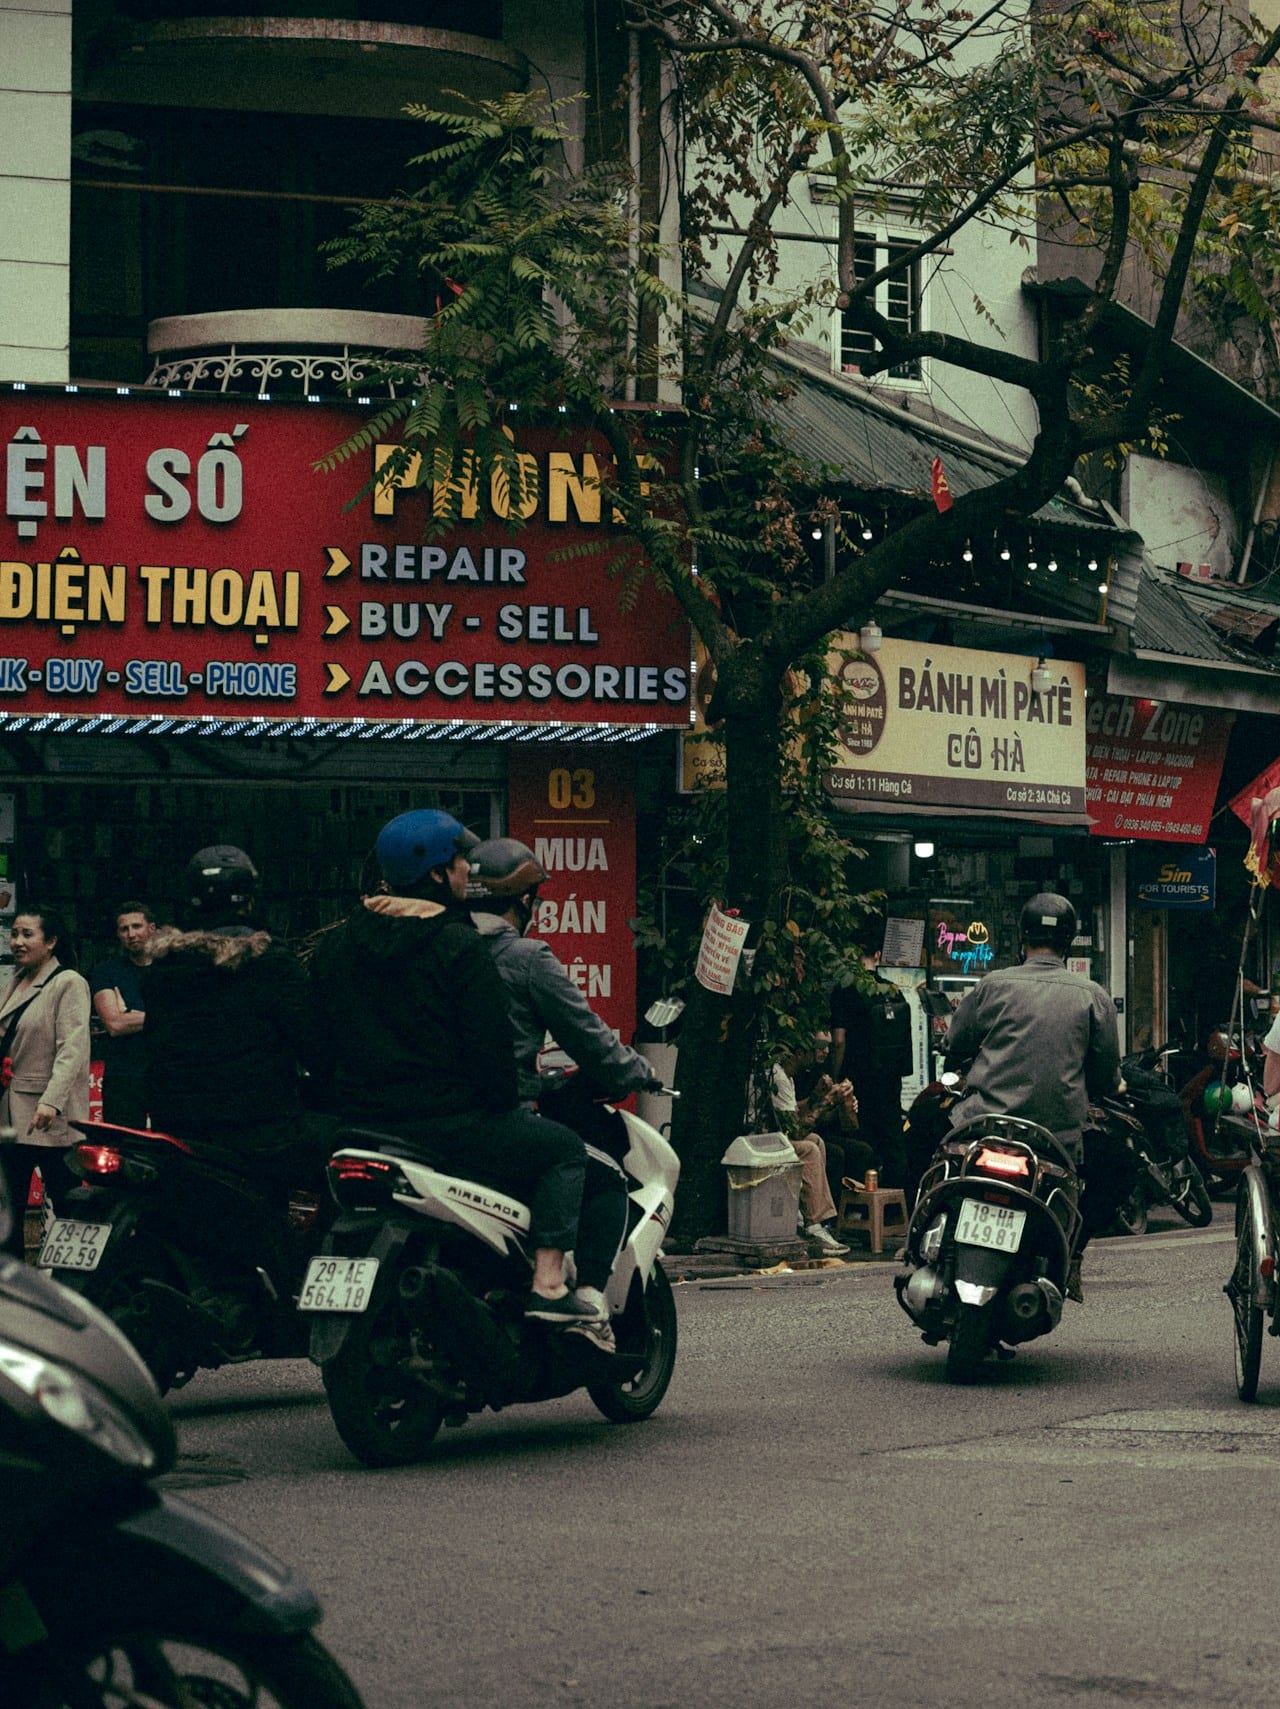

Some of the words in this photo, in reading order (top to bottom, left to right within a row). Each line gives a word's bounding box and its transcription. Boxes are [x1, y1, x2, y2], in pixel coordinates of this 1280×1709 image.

[145, 424, 249, 523] SỐ
[361, 544, 527, 582] REPAIR
[0, 547, 126, 635] ĐIỆN
[140, 566, 300, 644] THOẠI
[361, 602, 453, 637] BUY
[499, 604, 598, 641] SELL
[46, 659, 103, 692] BUY
[125, 660, 188, 696] SELL
[206, 661, 298, 697] PHONE
[359, 660, 687, 701] ACCESSORIES
[899, 658, 973, 717] BÁNH
[981, 668, 1007, 720] MÌ
[1014, 676, 1072, 727] PATÊ
[1141, 700, 1204, 746] Zone
[948, 727, 982, 769] CÔ
[991, 731, 1026, 773] HÀ
[1136, 749, 1162, 766] LAPTOP
[548, 768, 596, 810] 03
[868, 778, 877, 791] 11
[879, 775, 900, 797] Hàng
[901, 778, 912, 795] Cá
[1103, 768, 1128, 784] REPAIR
[1128, 770, 1152, 787] PHONE
[1158, 774, 1183, 790] LAPTOP
[1036, 789, 1046, 804] 3A
[1061, 790, 1071, 805] Cá
[534, 837, 608, 871] MUA
[1139, 884, 1159, 893] FOR
[1161, 885, 1209, 894] TOURISTS
[1157, 863, 1192, 883] Sim
[538, 893, 606, 933] BÁN
[973, 1203, 1016, 1230] 18-HA
[962, 1221, 1017, 1248] 149.81
[43, 1244, 98, 1267] 062.59
[314, 1261, 366, 1284] 29-AE
[303, 1285, 365, 1308] 564.18
